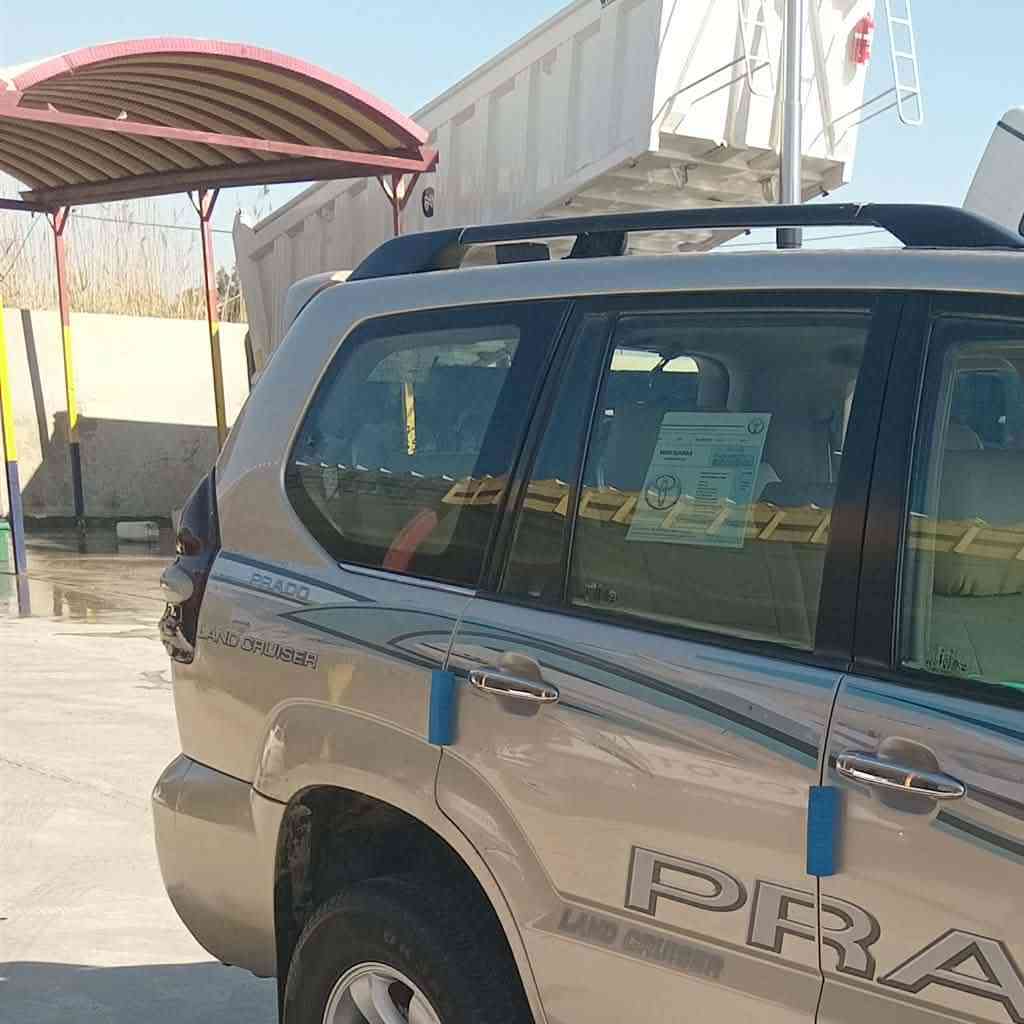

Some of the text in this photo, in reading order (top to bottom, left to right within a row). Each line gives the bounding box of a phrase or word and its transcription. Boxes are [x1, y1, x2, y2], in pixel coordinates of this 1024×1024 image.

[249, 572, 310, 601] PRADO
[198, 623, 319, 670] LAND CRUISER
